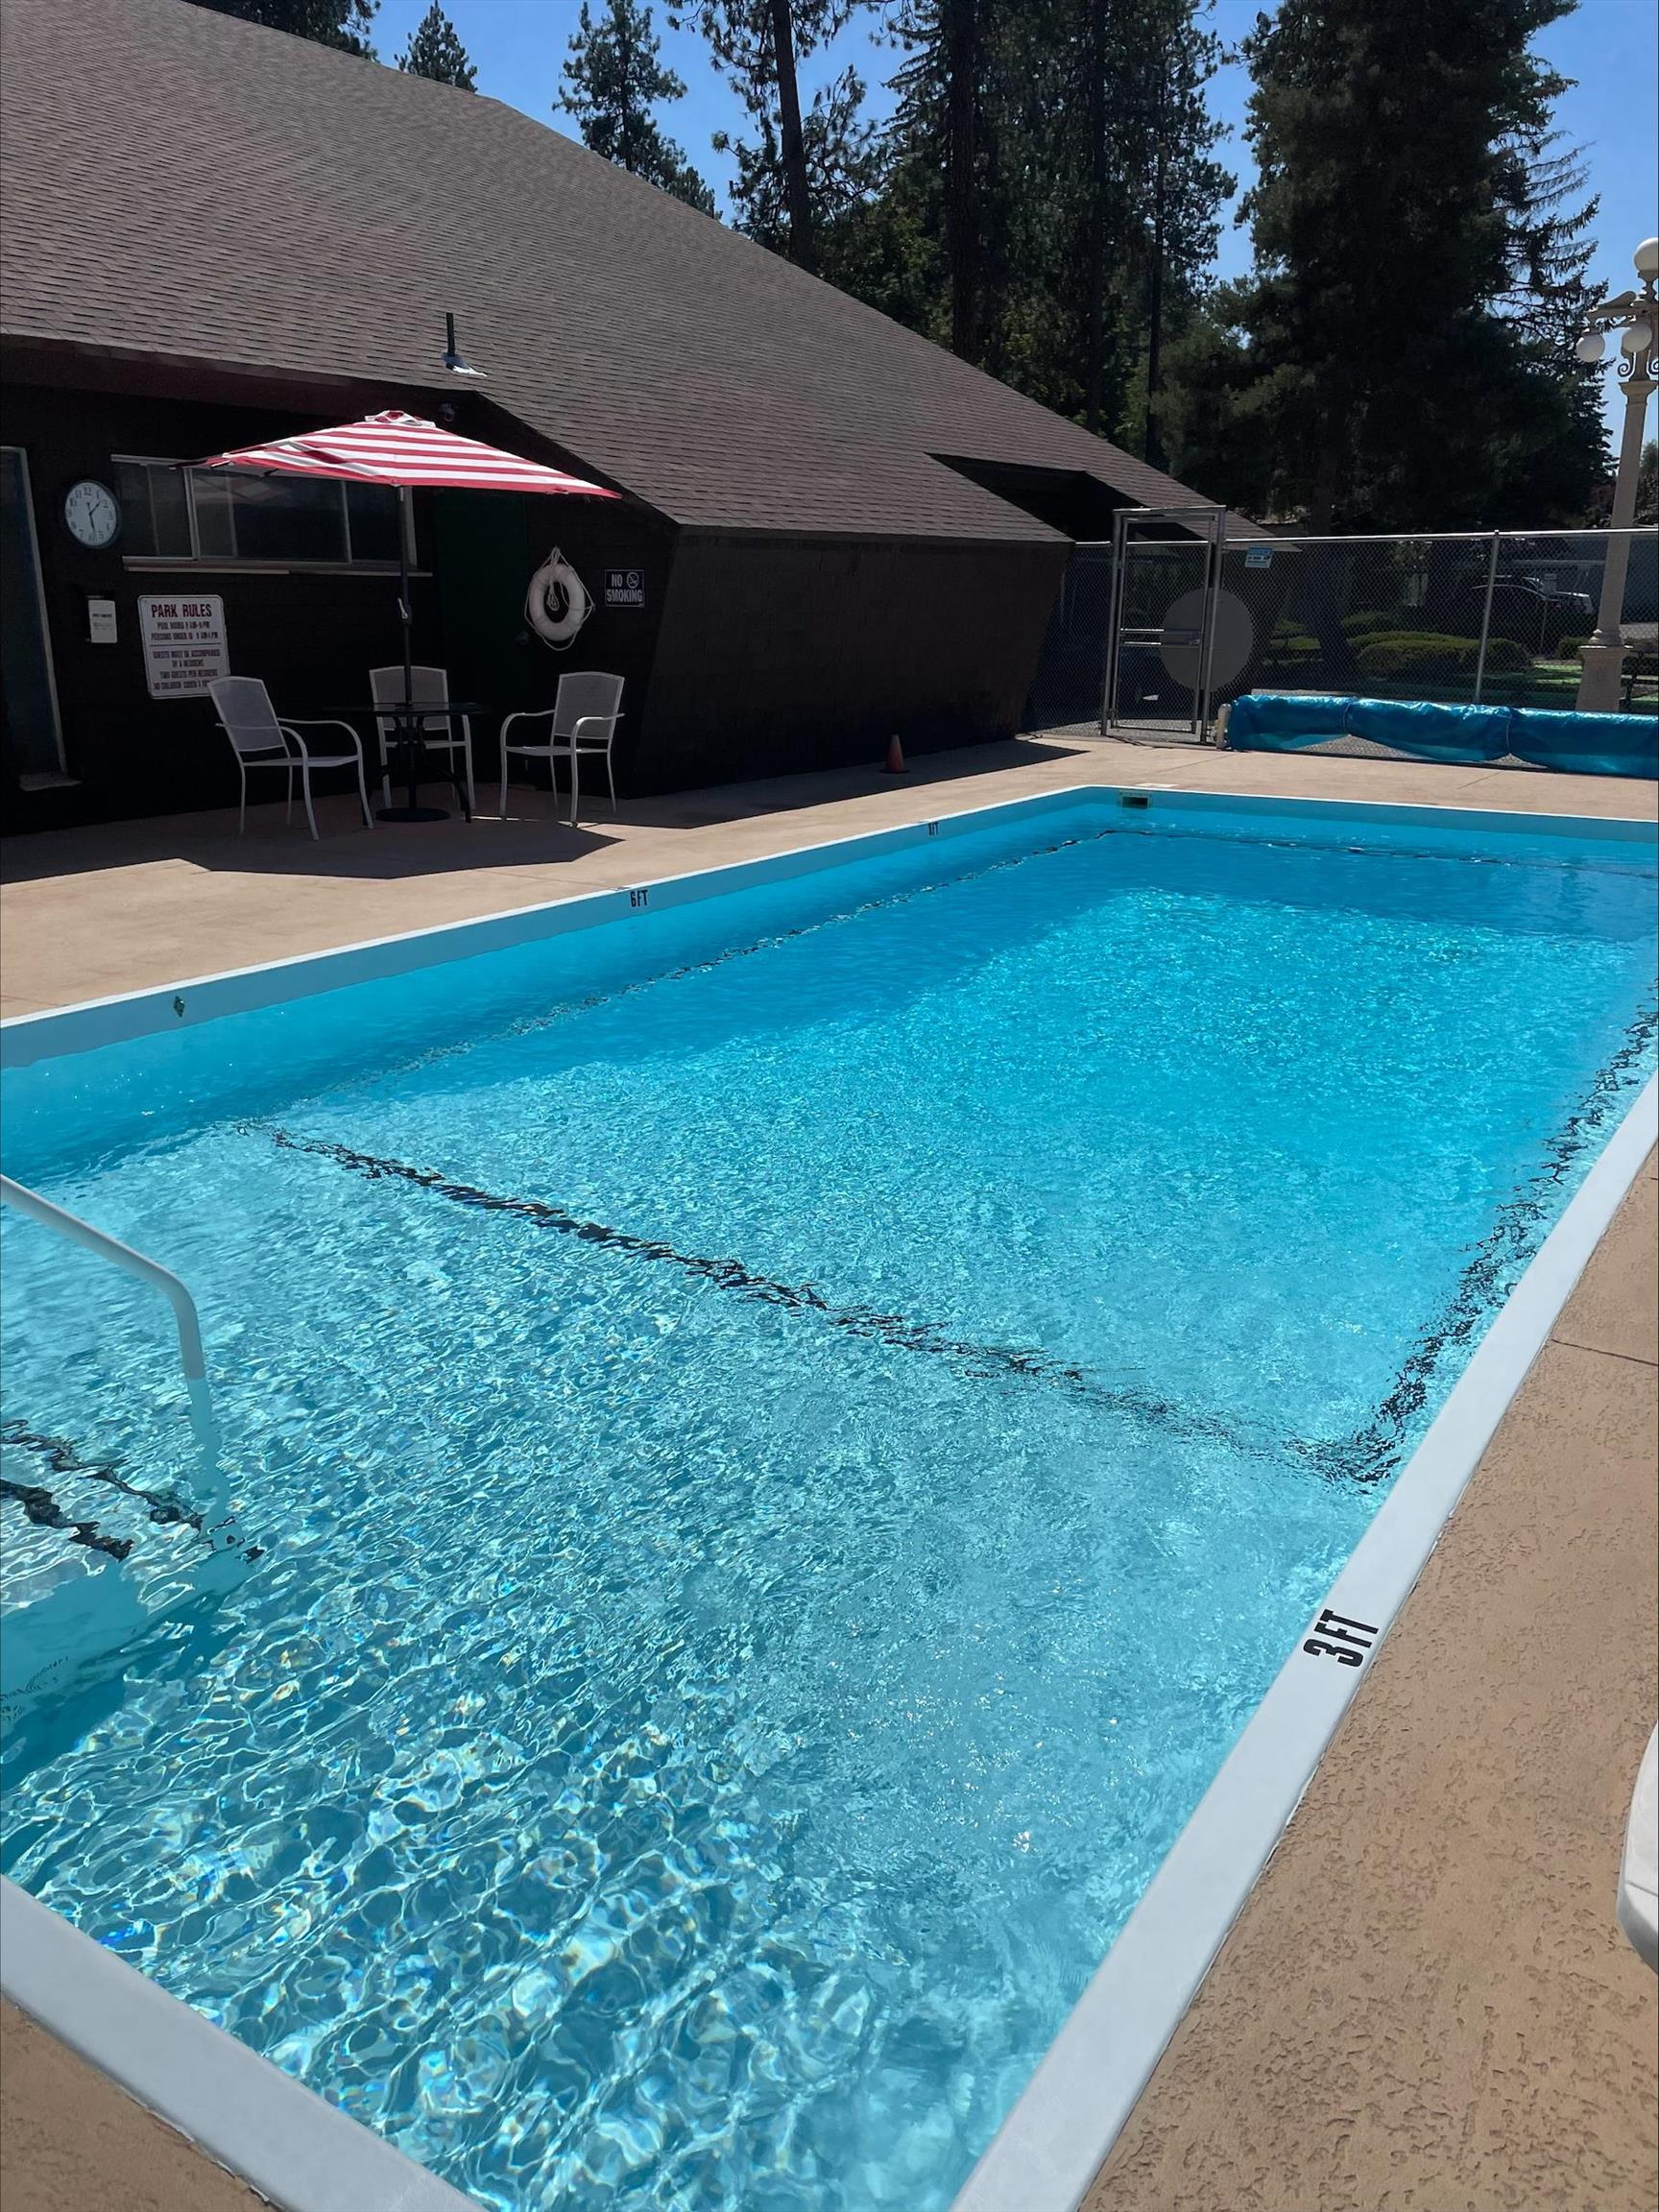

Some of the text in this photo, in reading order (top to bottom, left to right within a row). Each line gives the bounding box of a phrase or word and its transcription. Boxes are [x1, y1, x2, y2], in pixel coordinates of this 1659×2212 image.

[612, 574, 622, 587] NO
[607, 589, 642, 602] SMOKING
[152, 603, 212, 617] PARK RULES
[630, 890, 648, 907] 6FT
[1303, 1608, 1380, 1668] 3FT
